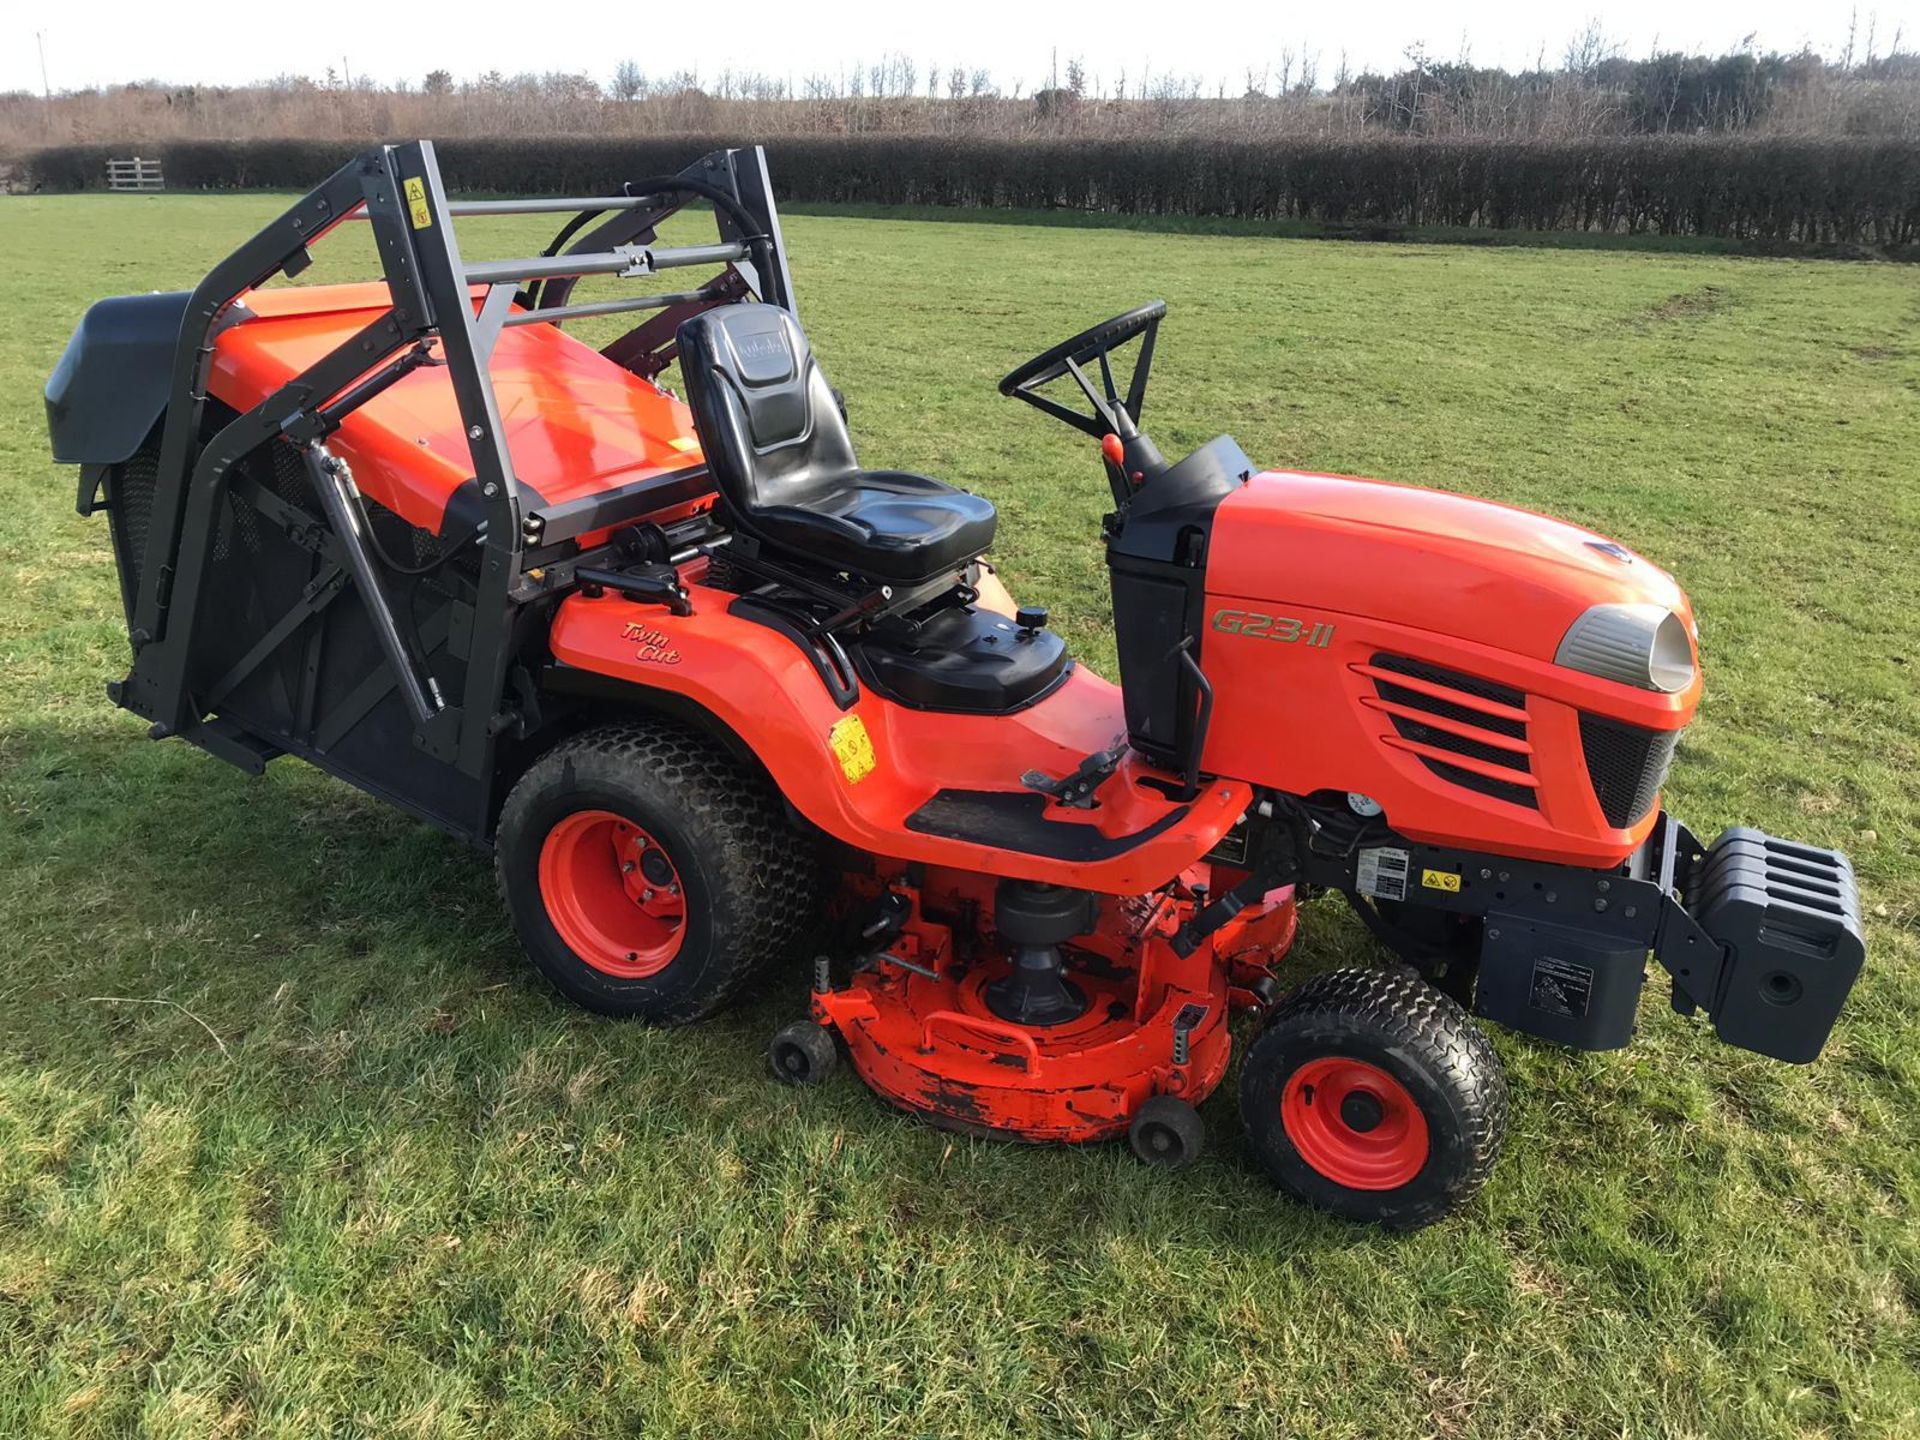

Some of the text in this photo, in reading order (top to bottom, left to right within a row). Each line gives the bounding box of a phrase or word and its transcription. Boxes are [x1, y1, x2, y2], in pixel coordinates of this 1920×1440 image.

[621, 622, 669, 648] Twin
[1212, 609, 1336, 648] G23-II
[636, 644, 681, 664] Cut
